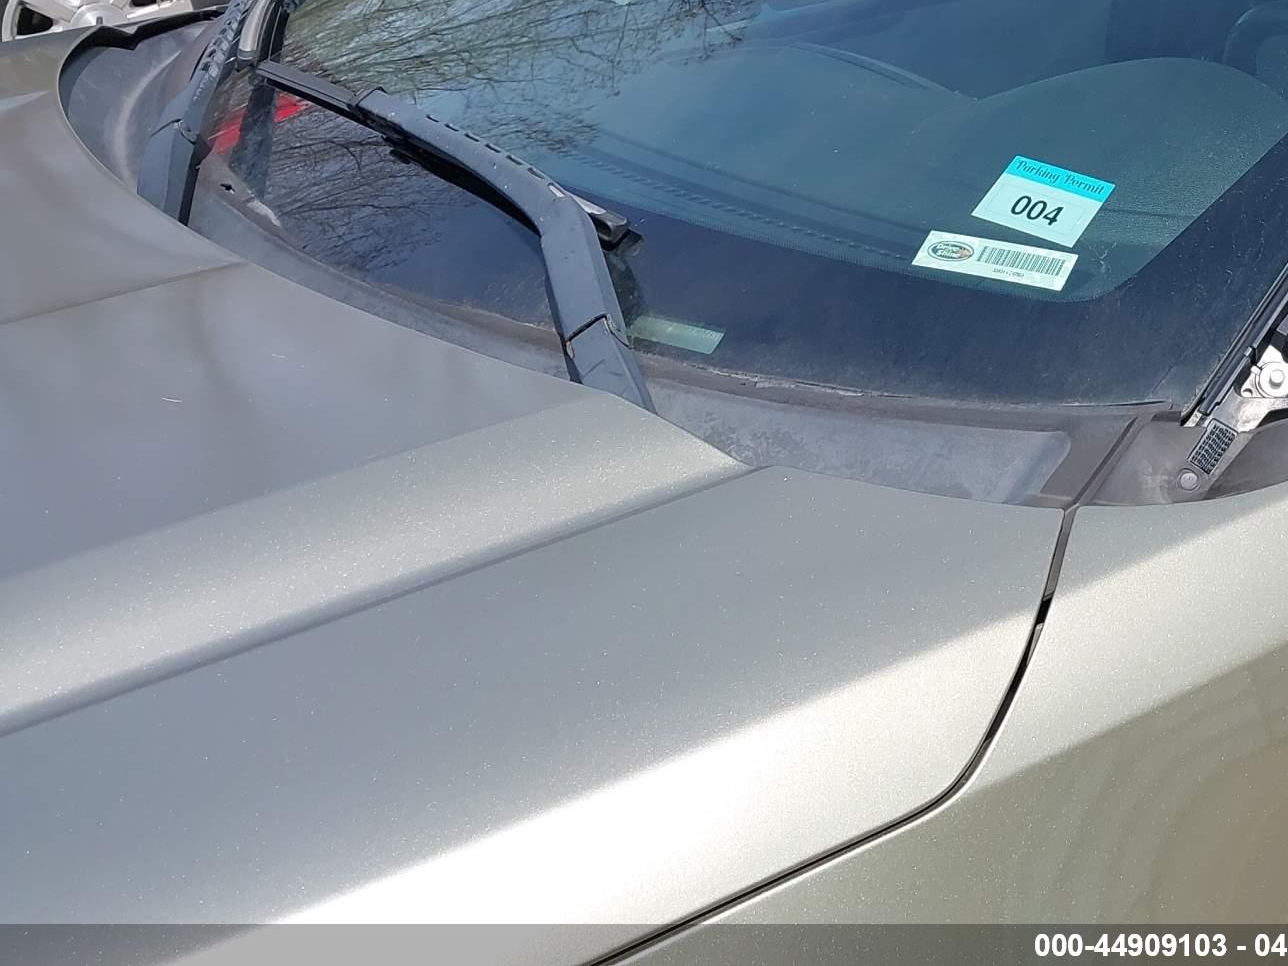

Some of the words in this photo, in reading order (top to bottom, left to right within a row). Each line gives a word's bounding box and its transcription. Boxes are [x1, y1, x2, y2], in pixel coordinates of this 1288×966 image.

[1017, 160, 1060, 183] Parking
[1064, 172, 1105, 194] Permit
[1010, 195, 1064, 226] 004
